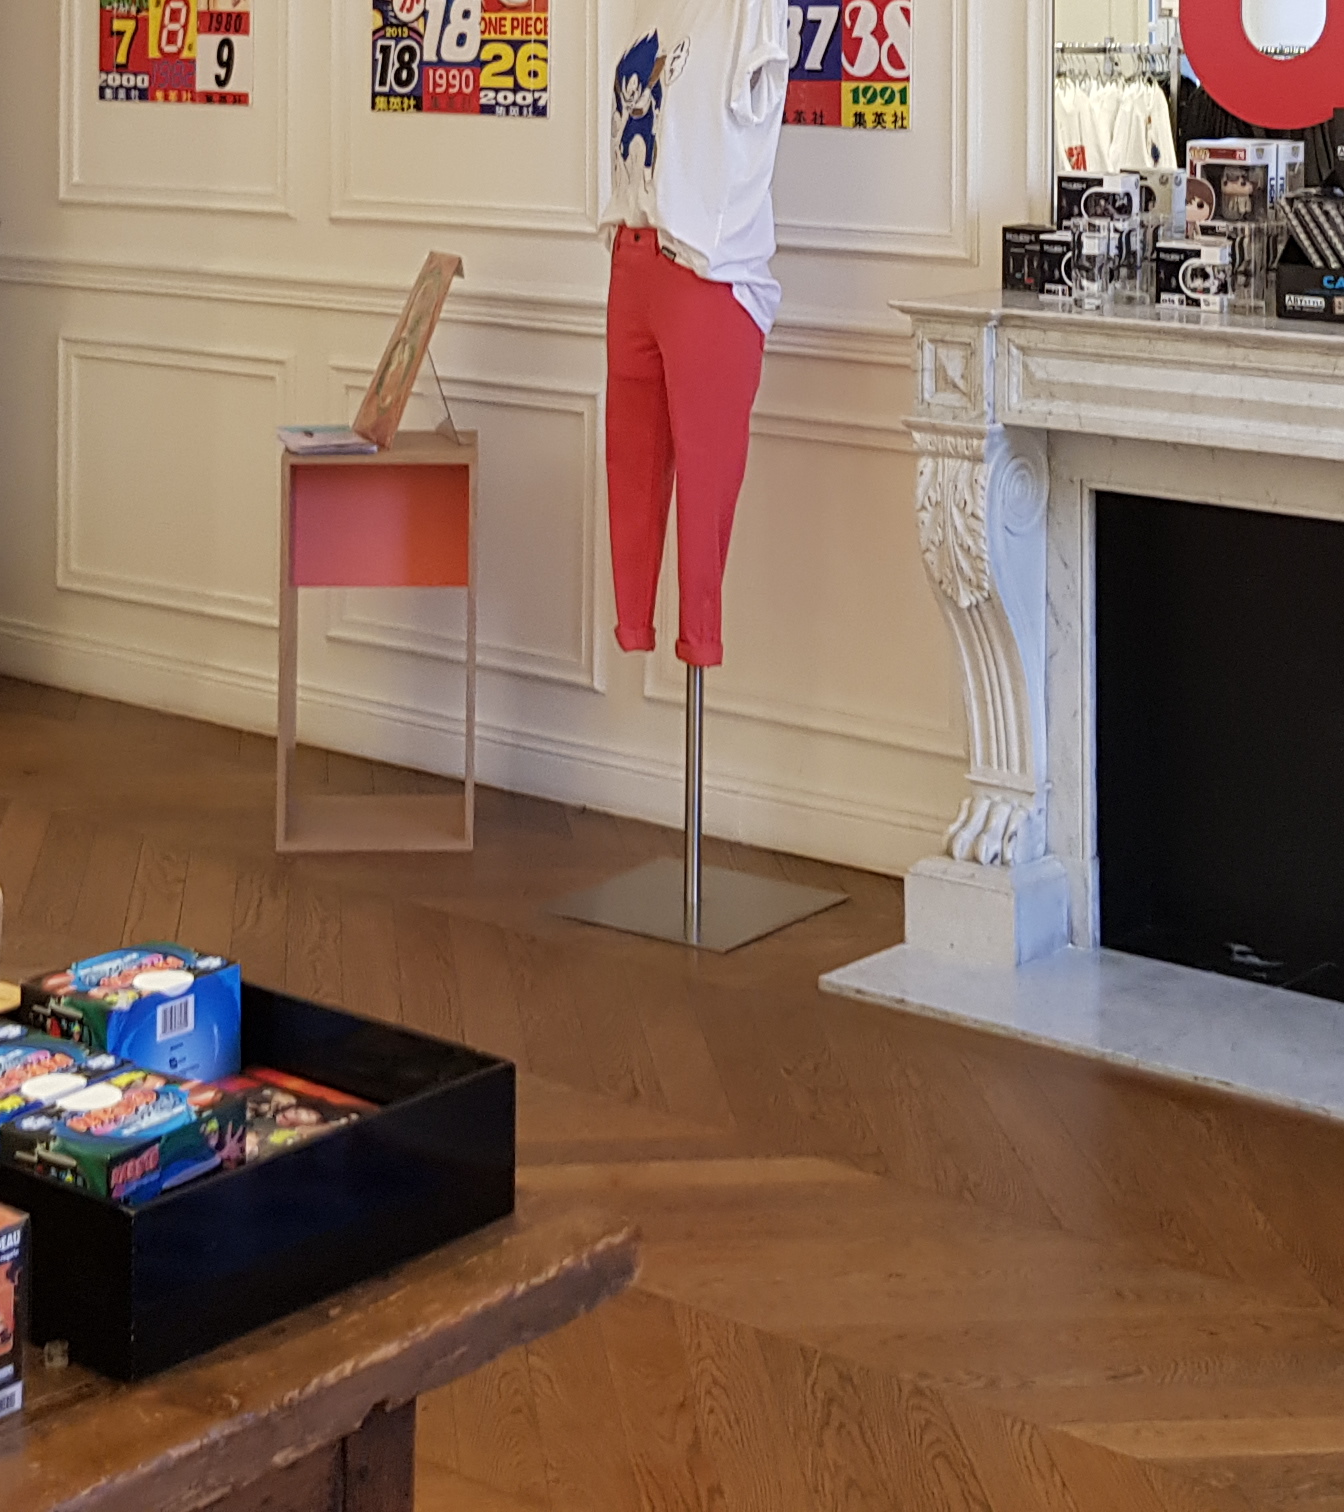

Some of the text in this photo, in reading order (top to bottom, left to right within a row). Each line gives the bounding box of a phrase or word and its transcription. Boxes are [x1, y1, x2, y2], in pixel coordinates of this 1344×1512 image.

[111, 17, 139, 69] 7
[207, 12, 244, 33] 1980
[214, 37, 235, 89] 9
[375, 39, 421, 93] 18
[428, 68, 475, 95] 1990
[480, 42, 549, 90] 26
[850, 84, 908, 106] 1991
